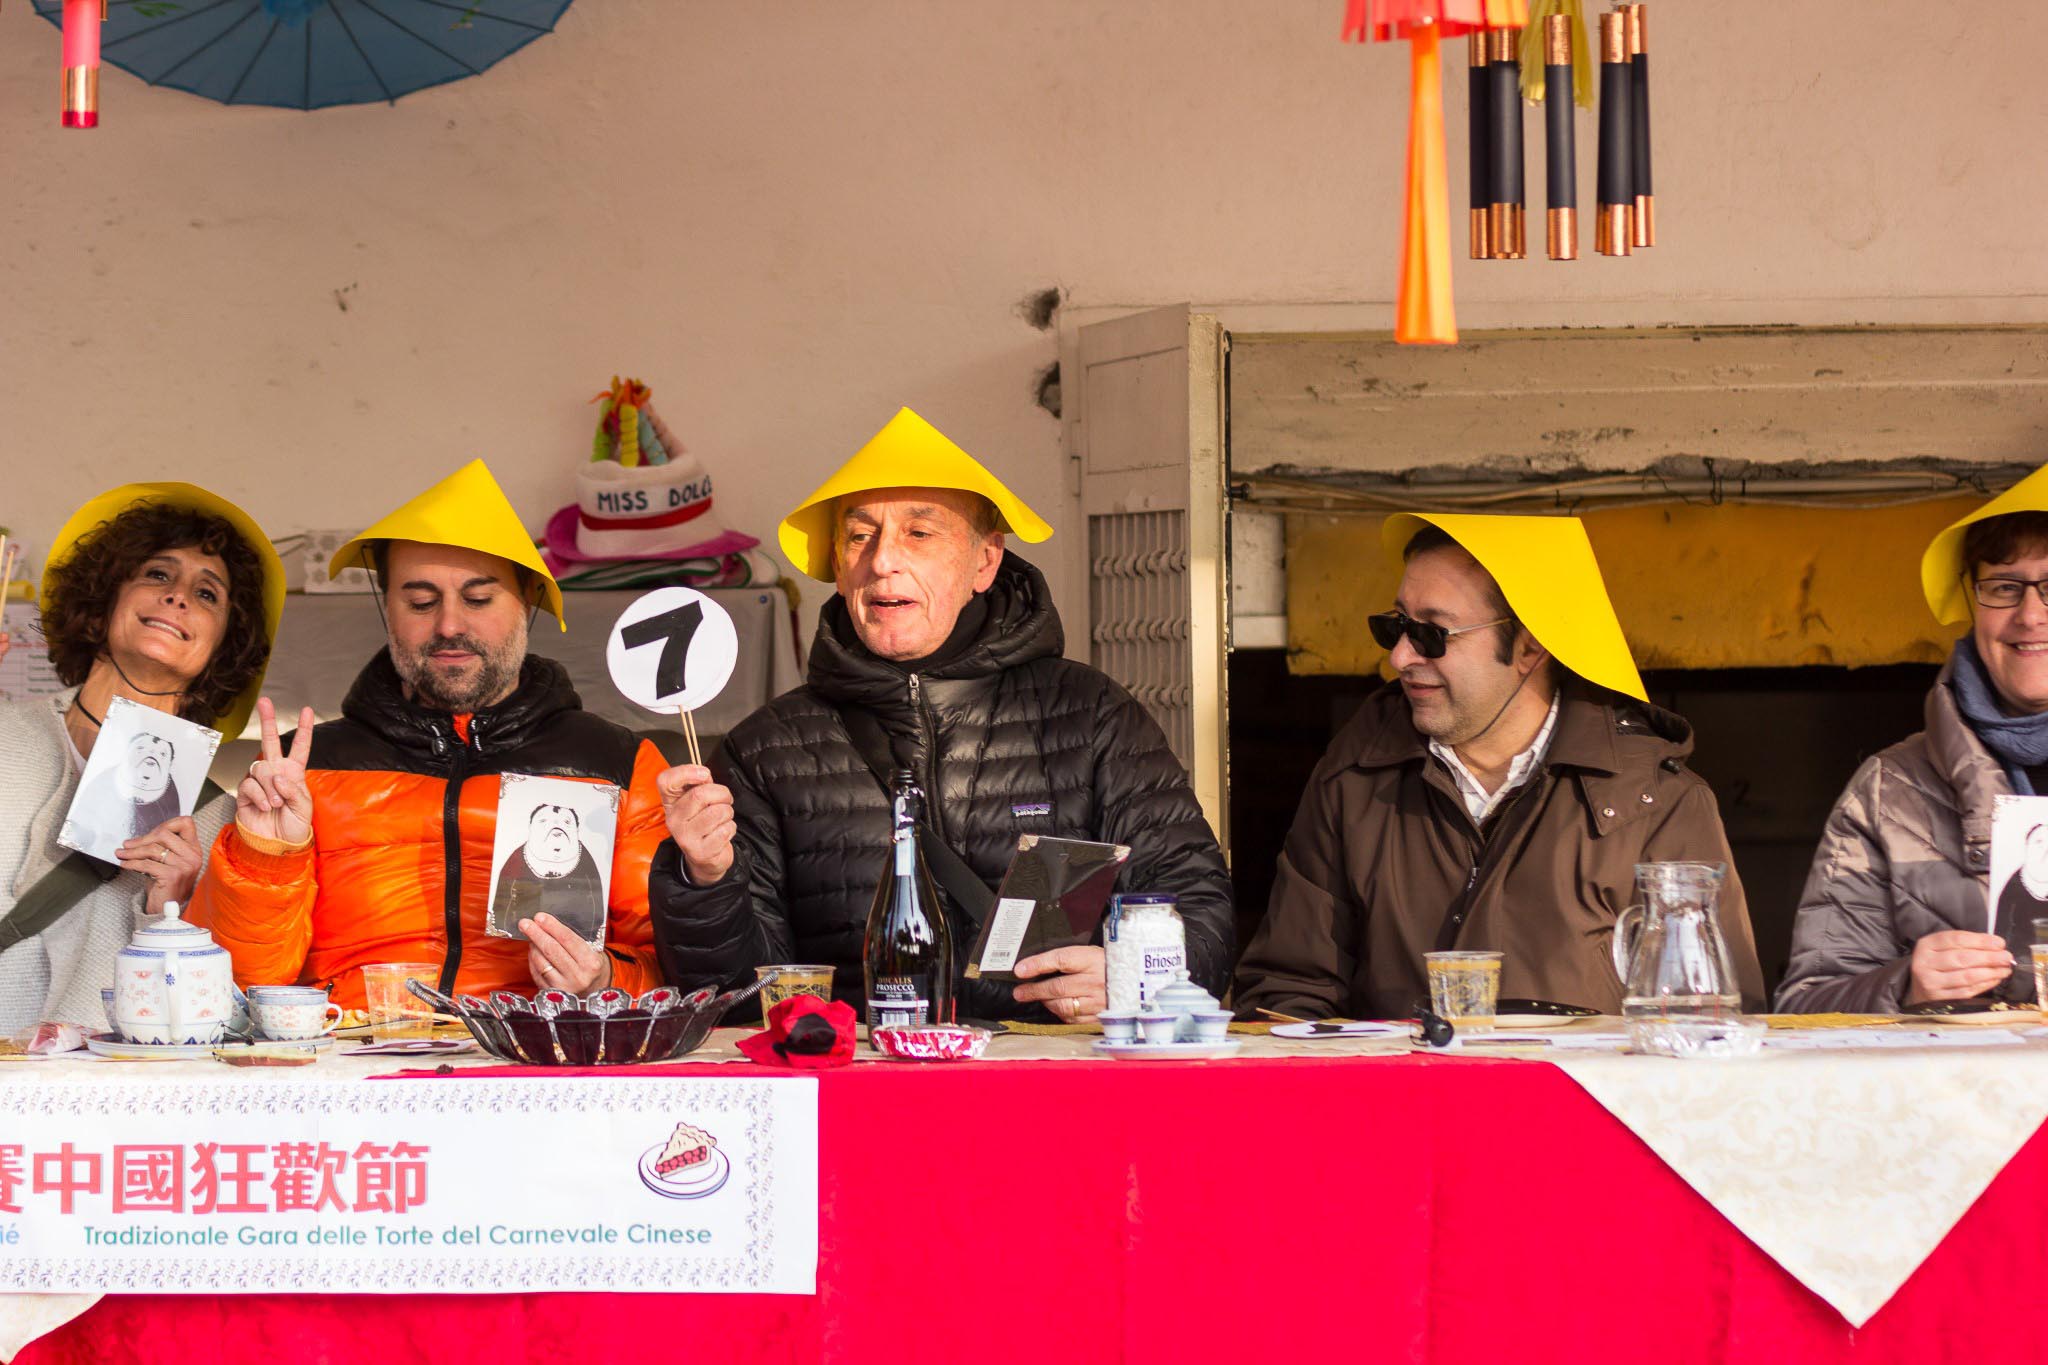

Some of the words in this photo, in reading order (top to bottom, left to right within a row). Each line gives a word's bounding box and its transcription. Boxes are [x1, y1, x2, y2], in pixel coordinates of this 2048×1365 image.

[598, 490, 649, 512] MISS
[621, 600, 704, 700] 7
[876, 983, 915, 992] PROSECCO
[84, 1225, 229, 1246] Tradizionale
[238, 1225, 299, 1246] Gara
[307, 1225, 367, 1246] delle
[375, 1225, 434, 1246] Torte
[442, 1225, 481, 1245] del
[489, 1223, 619, 1245] Carnevale
[627, 1223, 713, 1244] Cinese
